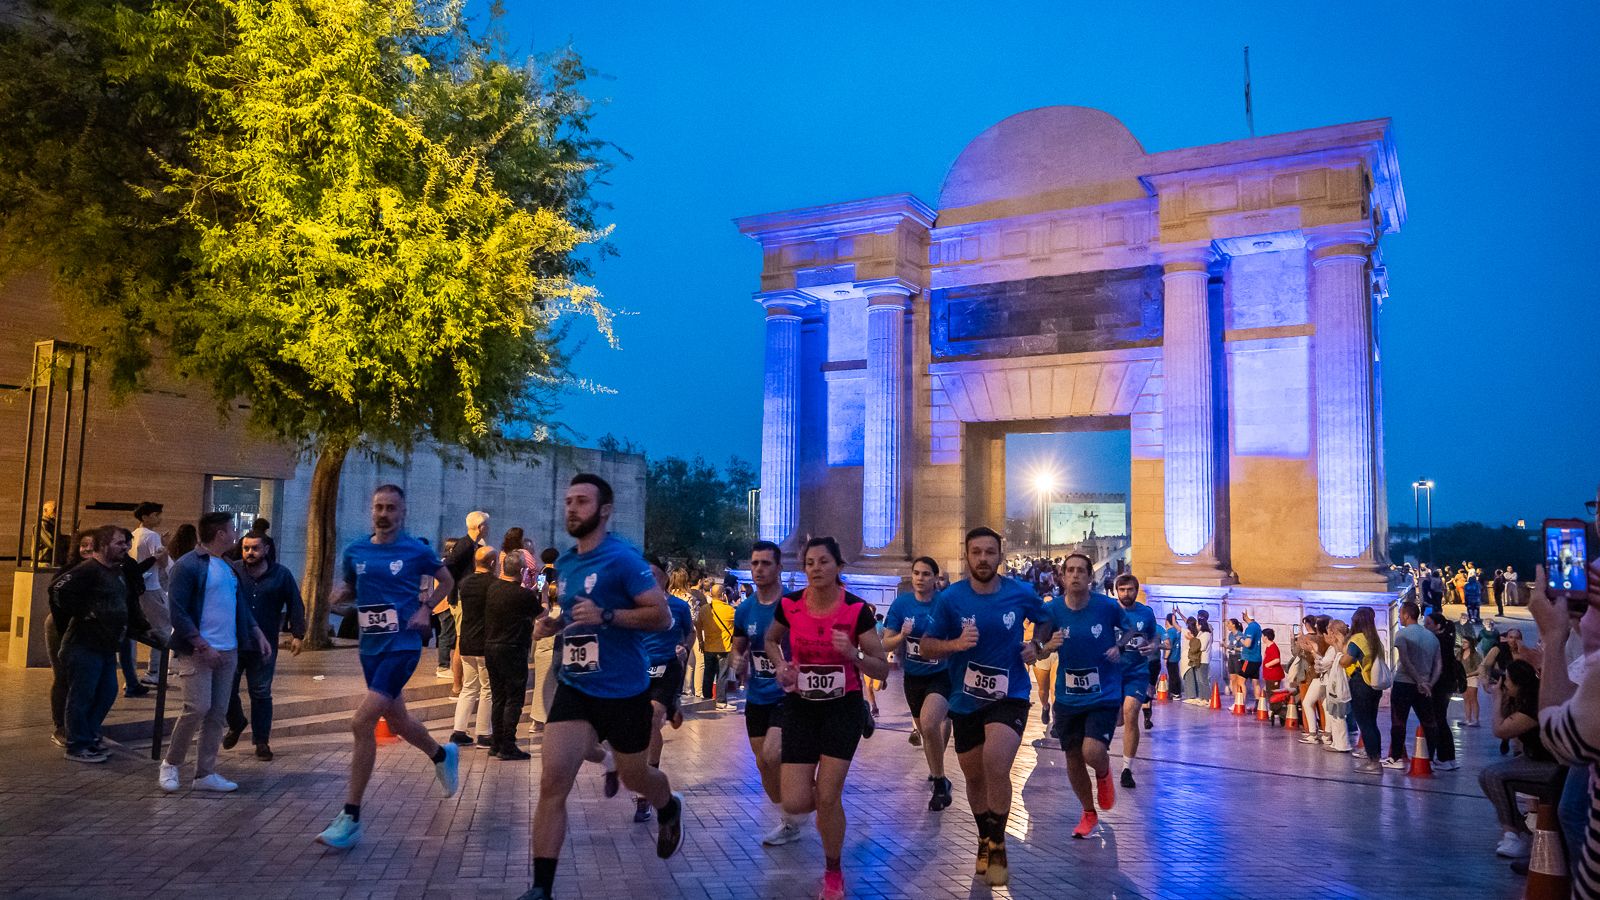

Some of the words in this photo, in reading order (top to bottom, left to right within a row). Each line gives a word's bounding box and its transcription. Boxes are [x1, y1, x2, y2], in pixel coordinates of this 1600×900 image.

[368, 613, 387, 624] 534
[570, 648, 587, 661] 319
[807, 676, 835, 689] 1307
[974, 675, 997, 690] 356
[1073, 676, 1090, 687] 451
